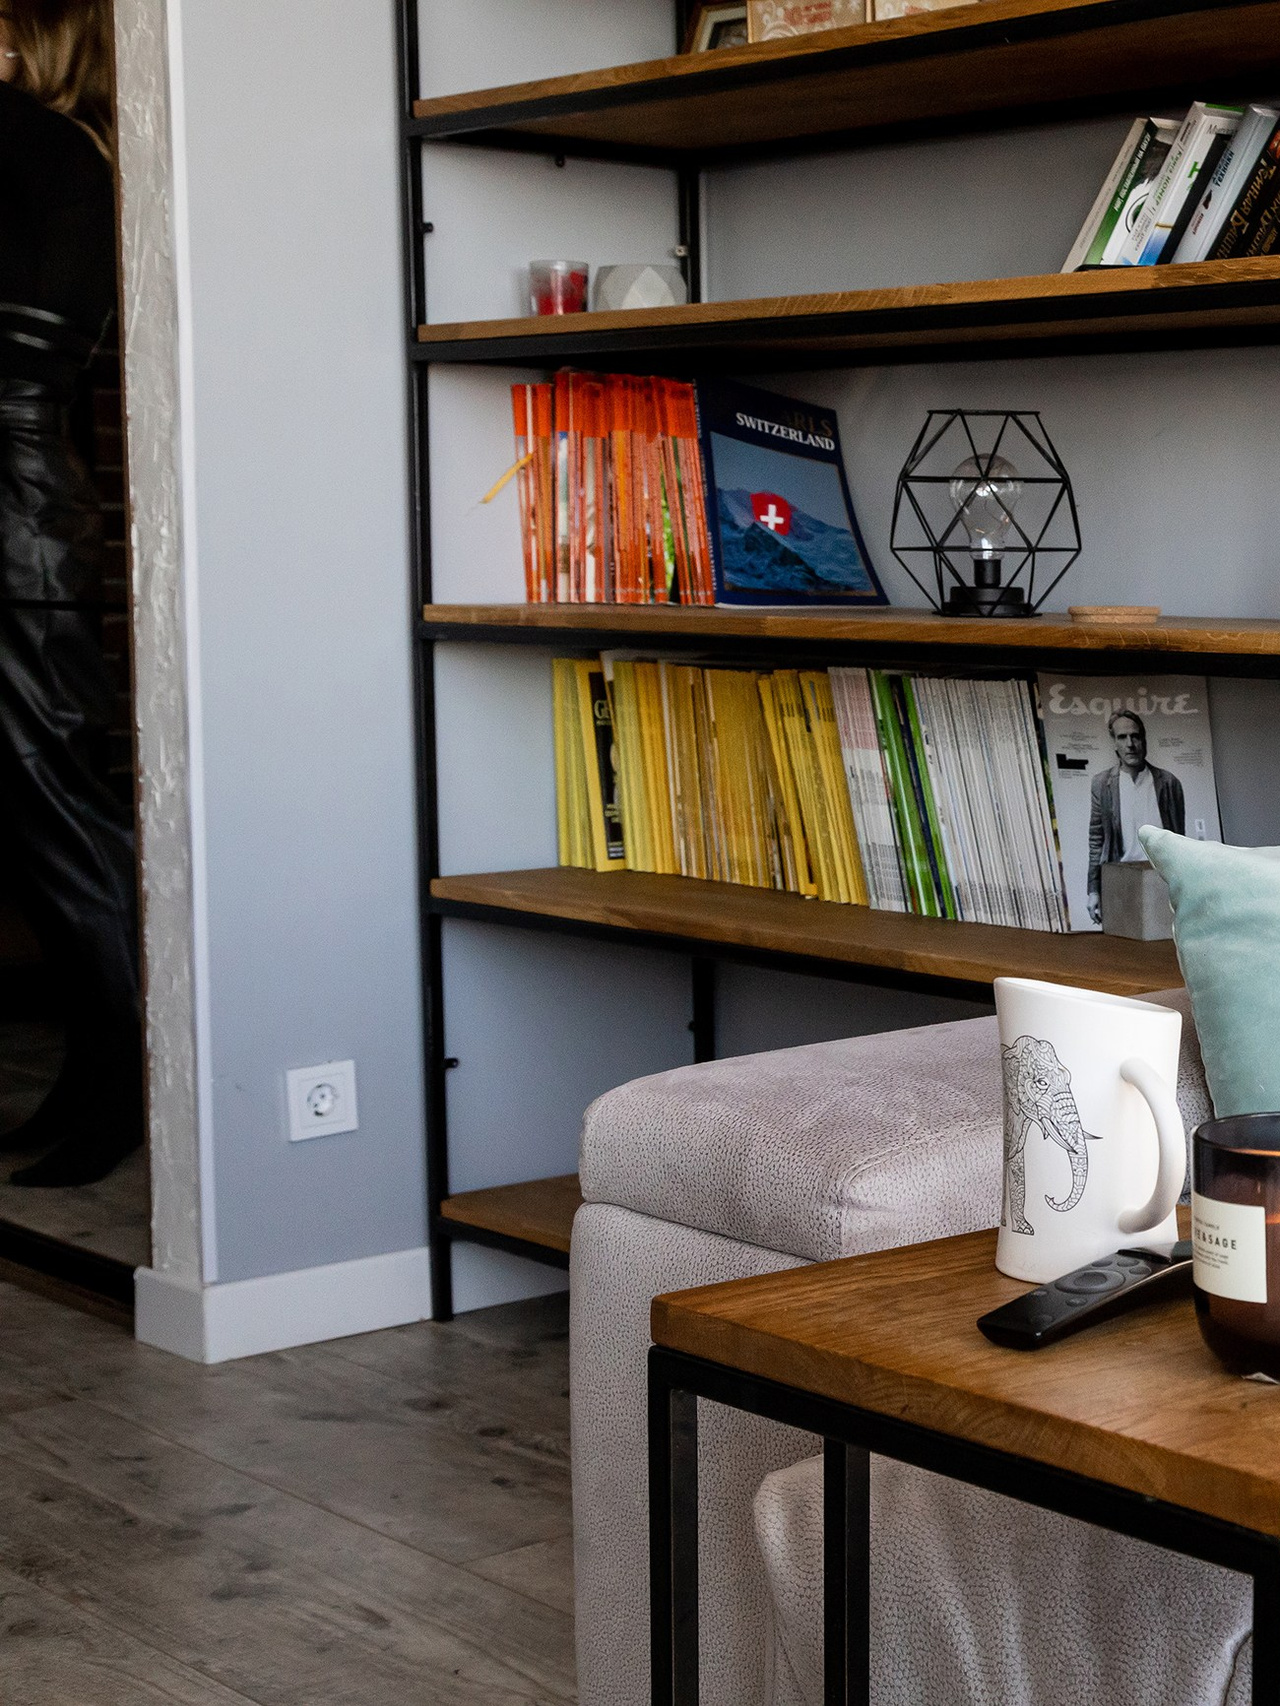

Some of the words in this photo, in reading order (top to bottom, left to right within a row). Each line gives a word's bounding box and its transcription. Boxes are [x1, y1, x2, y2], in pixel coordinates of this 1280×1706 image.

[1136, 148, 1145, 158] НА
[1152, 175, 1171, 206] НОМЕР
[736, 412, 835, 451] SWITZERLAND
[1049, 683, 1198, 724] Esquire
